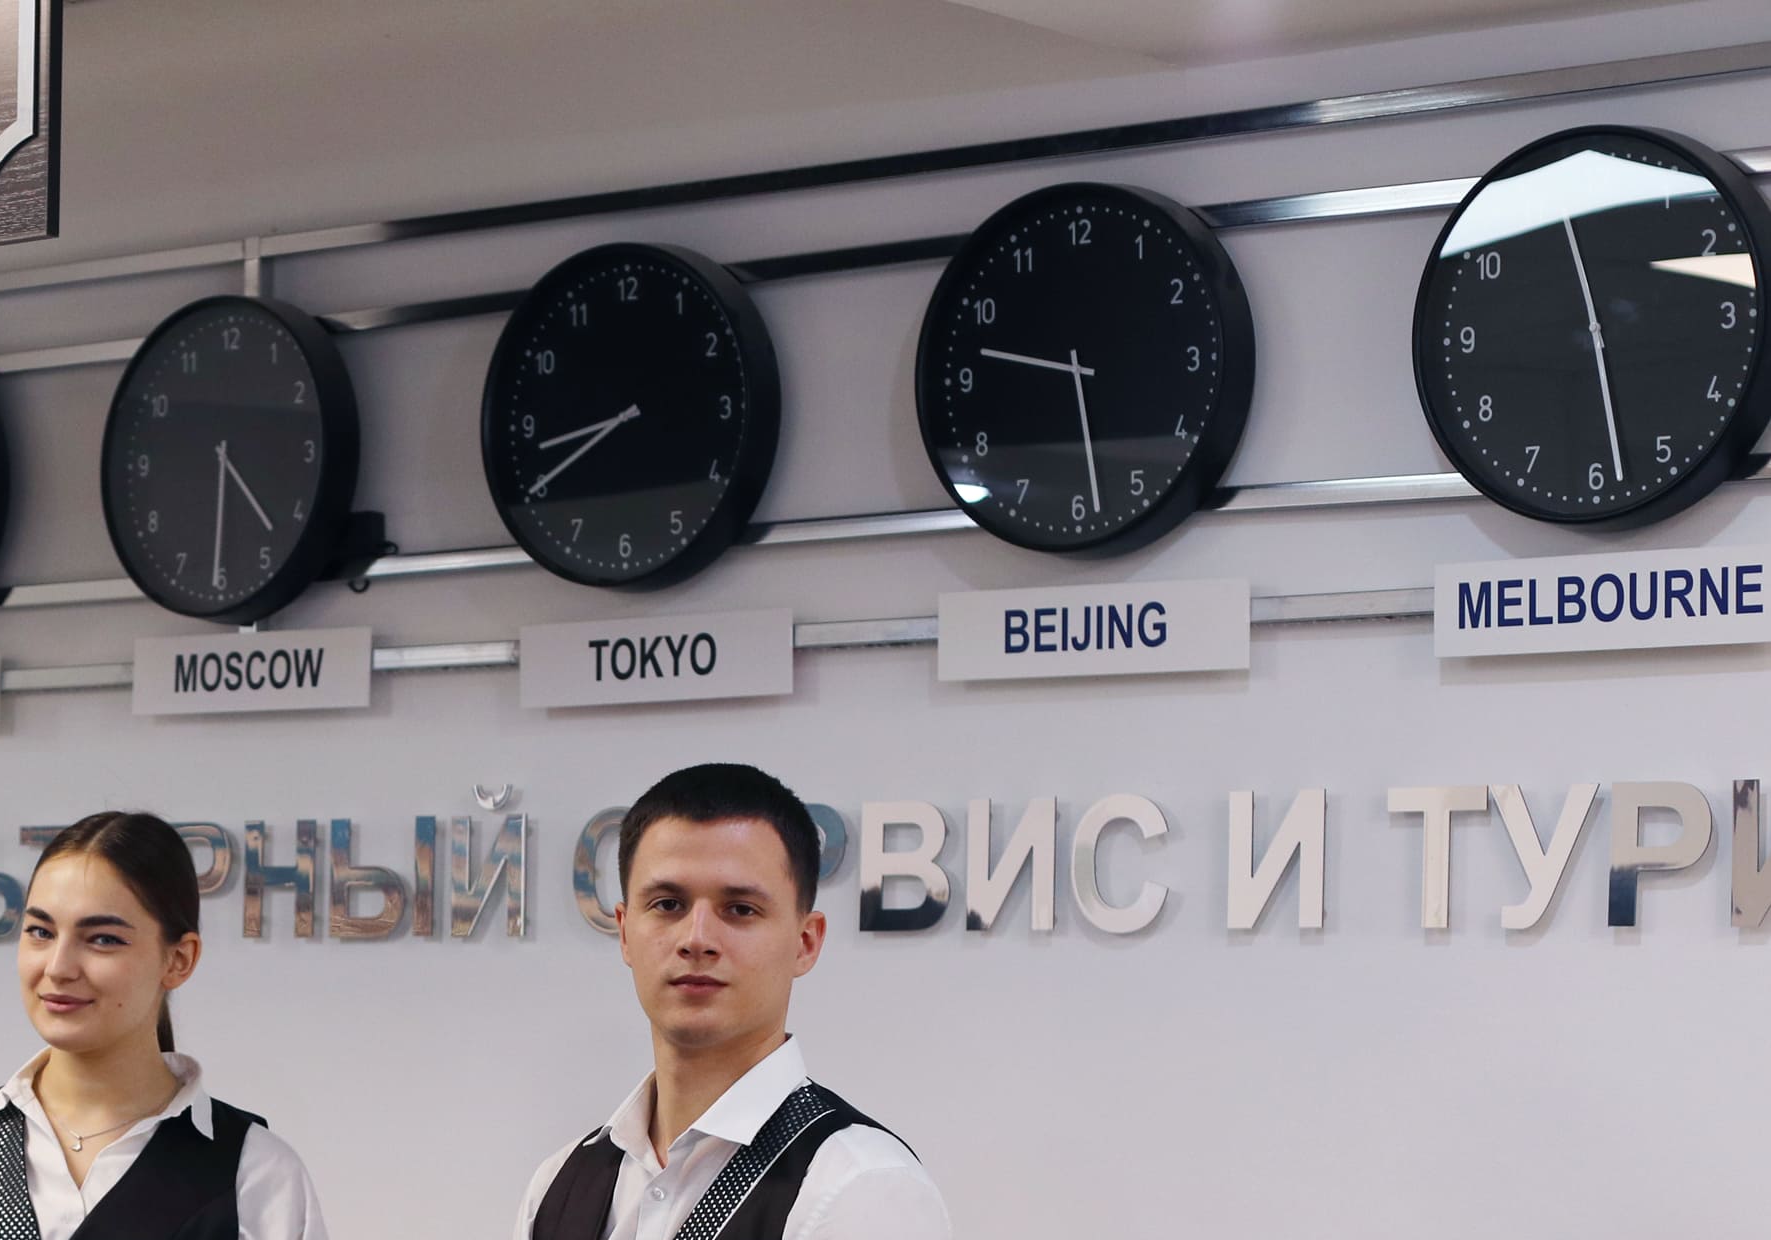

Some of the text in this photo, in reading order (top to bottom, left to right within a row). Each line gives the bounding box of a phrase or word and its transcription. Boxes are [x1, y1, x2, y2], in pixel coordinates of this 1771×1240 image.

[1067, 219, 1092, 246] 12
[1701, 229, 1717, 257] 2
[1013, 247, 1033, 273] 11
[1135, 234, 1143, 260] 1
[1476, 251, 1501, 280] 10
[617, 276, 639, 302] 12
[1170, 278, 1184, 305] 2
[569, 303, 588, 327] 11
[676, 291, 684, 315] 1
[973, 298, 995, 325] 10
[1720, 302, 1736, 330] 3
[222, 327, 241, 350] 12
[705, 332, 718, 357] 2
[1460, 326, 1476, 354] 9
[179, 351, 197, 374] 11
[270, 343, 277, 364] 1
[535, 350, 555, 375] 10
[1187, 346, 1200, 371] 3
[294, 381, 306, 404] 2
[959, 367, 973, 393] 9
[1706, 375, 1722, 403] 4
[151, 394, 169, 417] 10
[719, 396, 732, 420] 3
[1478, 394, 1493, 422] 8
[522, 414, 535, 439] 9
[1174, 414, 1188, 439] 4
[304, 439, 315, 463] 3
[975, 431, 989, 457] 8
[1656, 436, 1672, 464] 5
[137, 454, 150, 477] 9
[709, 459, 720, 483] 4
[1525, 445, 1541, 474] 7
[1130, 470, 1145, 496] 5
[1588, 462, 1604, 491] 6
[1016, 479, 1029, 505] 7
[293, 500, 304, 521] 4
[1071, 495, 1086, 521] 6
[147, 510, 159, 533] 8
[571, 518, 583, 542] 7
[670, 510, 683, 535] 5
[259, 546, 271, 569] 5
[619, 533, 632, 558] 6
[176, 552, 187, 575] 7
[1458, 565, 1763, 629] MELBOURNE
[1004, 602, 1167, 654] BEIJING
[588, 632, 717, 682] TOKYO
[174, 648, 324, 693] MOSCOW
[573, 792, 1170, 937] СВИС
[1227, 788, 1327, 931] И
